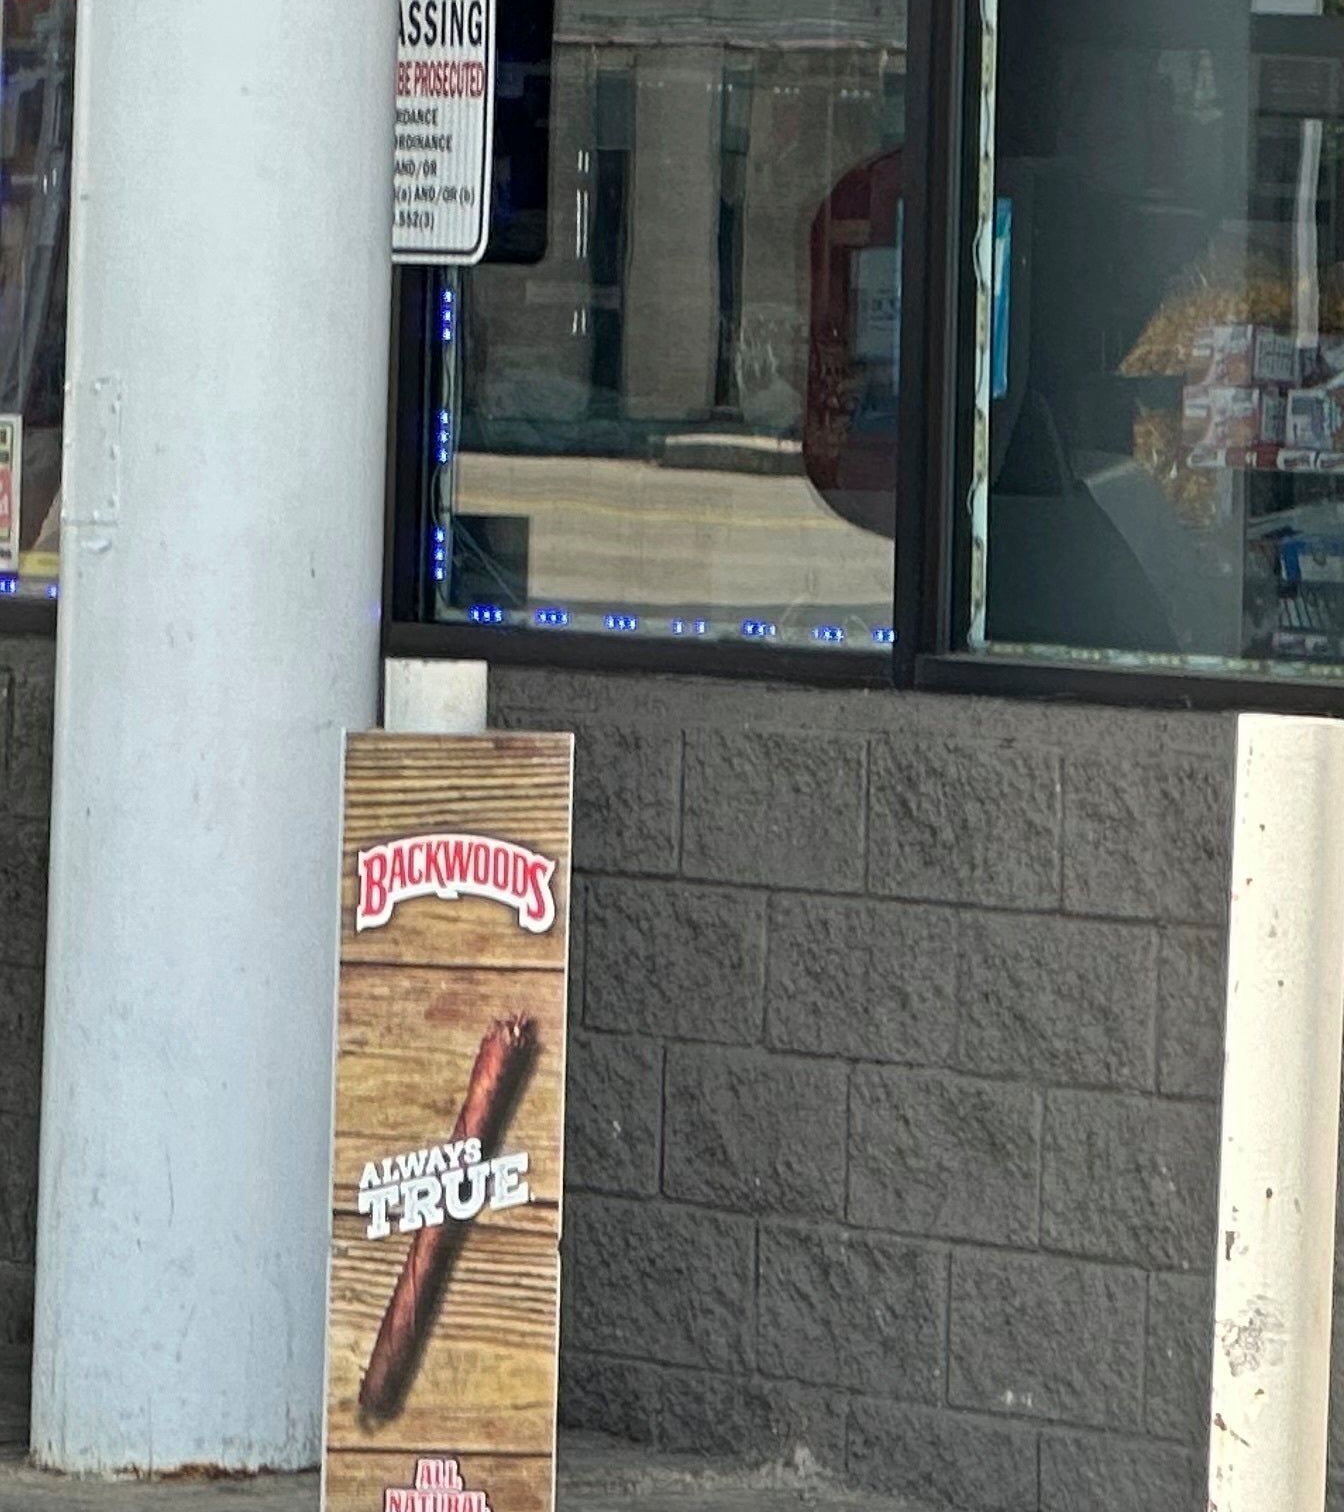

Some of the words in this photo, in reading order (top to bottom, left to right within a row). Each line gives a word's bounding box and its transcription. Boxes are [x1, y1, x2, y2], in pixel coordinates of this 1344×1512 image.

[414, 60, 485, 98] PROSECUTED
[361, 839, 548, 922] BACKWOODS
[359, 1137, 482, 1191] ALWAYS
[358, 1152, 529, 1240] TRUE
[420, 1461, 461, 1488] ALL
